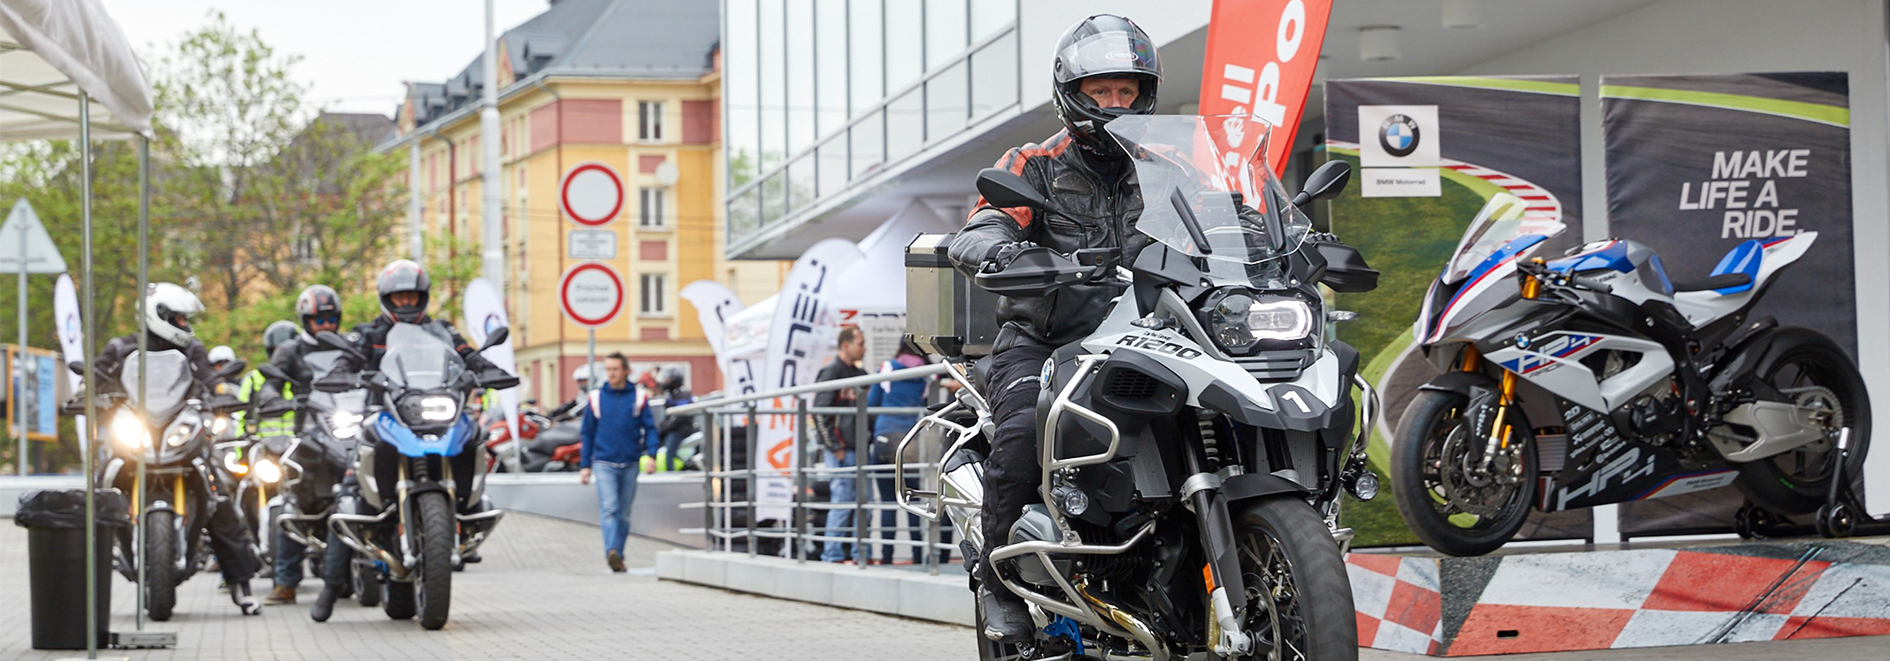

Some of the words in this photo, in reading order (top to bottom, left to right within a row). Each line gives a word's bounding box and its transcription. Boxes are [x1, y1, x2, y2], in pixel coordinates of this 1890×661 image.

[1711, 149, 1810, 179] MAKE
[1679, 180, 1750, 210] LIFE
[1753, 180, 1779, 208] A
[1721, 209, 1804, 238] RIDE.
[1115, 334, 1202, 360] R1200
[1281, 390, 1312, 413] 1
[1556, 447, 1656, 511] HP4
